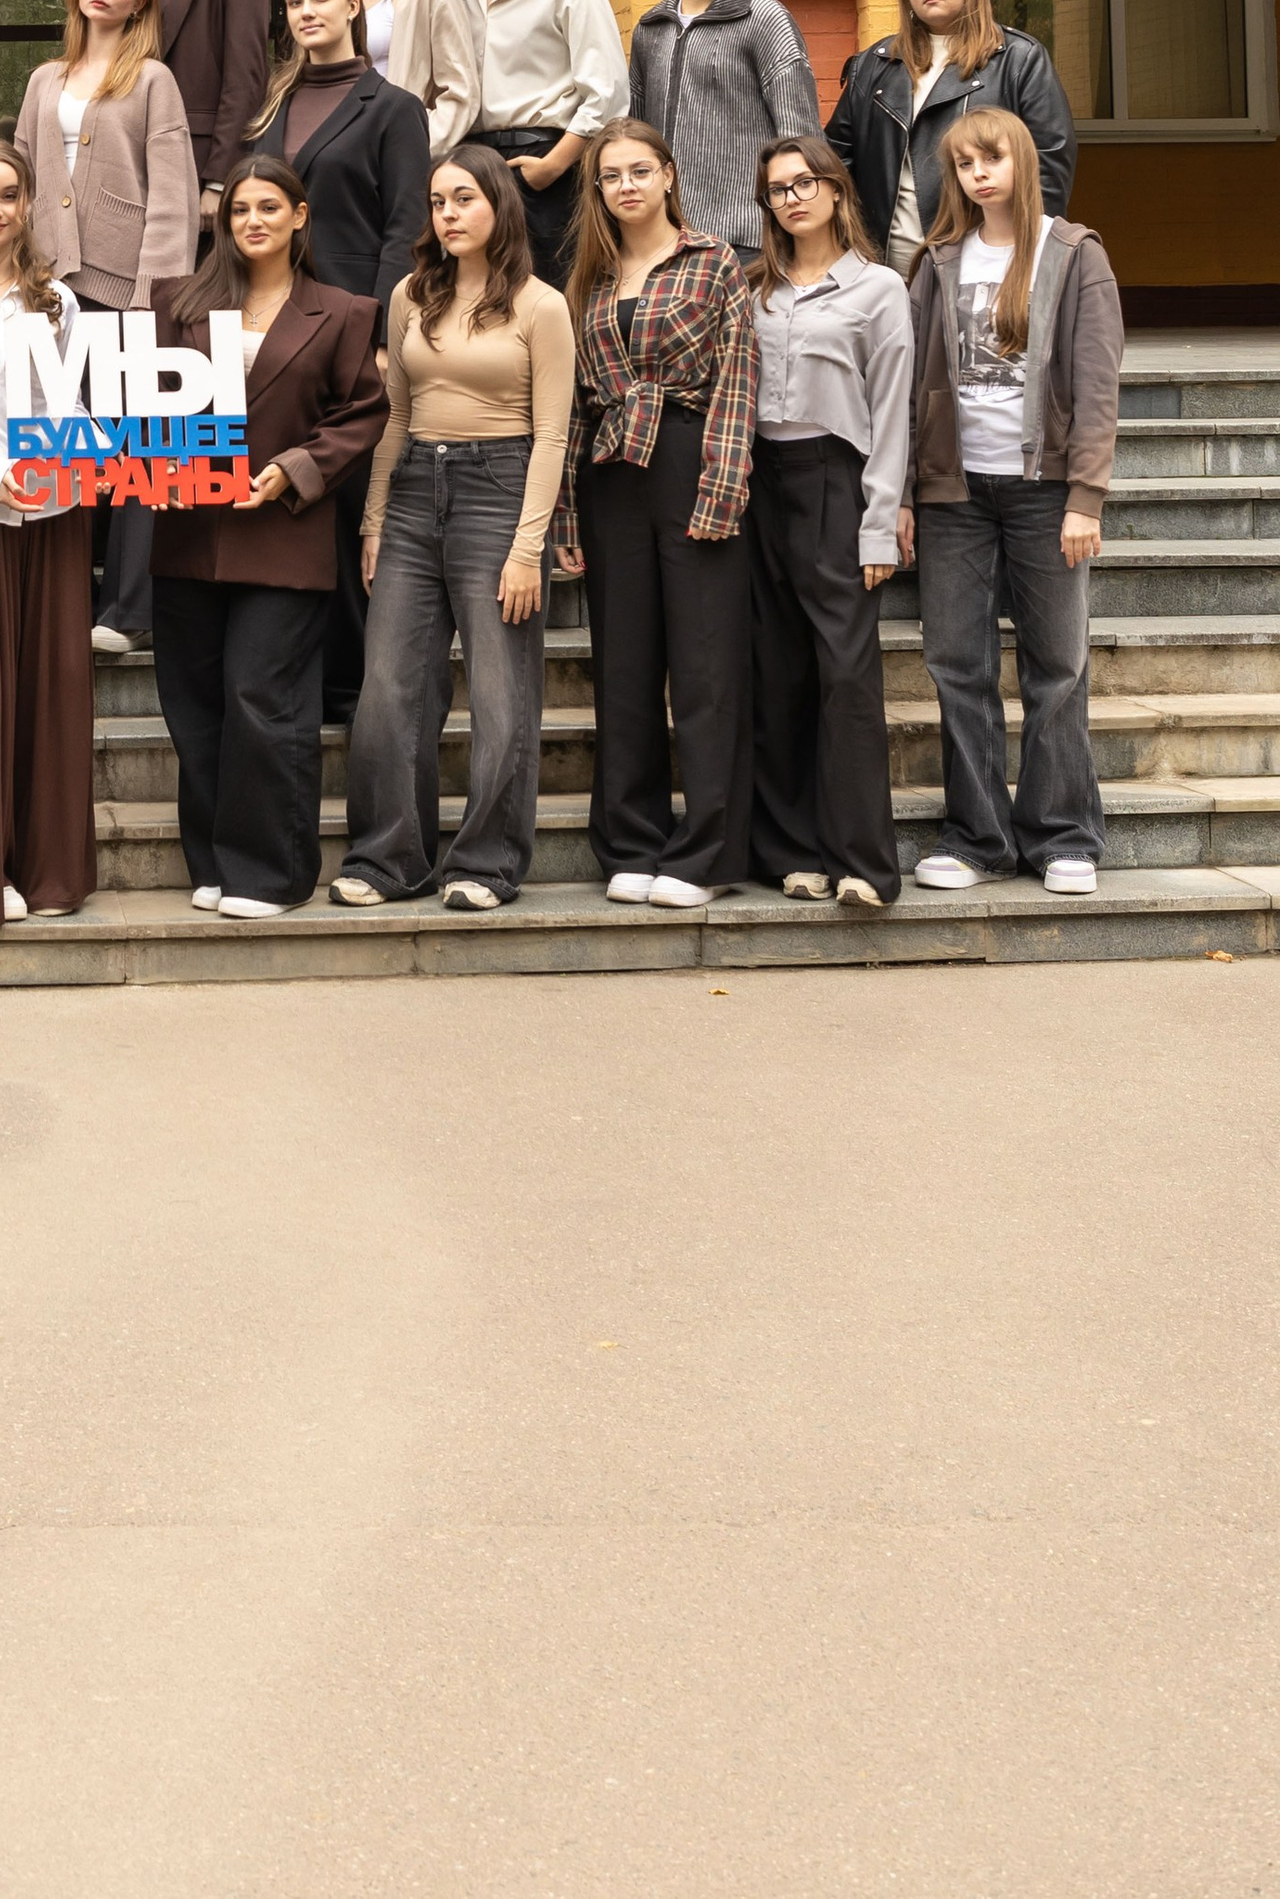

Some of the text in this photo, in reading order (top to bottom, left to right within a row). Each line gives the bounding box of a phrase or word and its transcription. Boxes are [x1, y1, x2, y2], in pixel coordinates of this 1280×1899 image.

[4, 309, 248, 419] МЫ
[7, 414, 249, 468] БУДУЩЕЕ
[10, 455, 251, 507] СТРАНЫ
